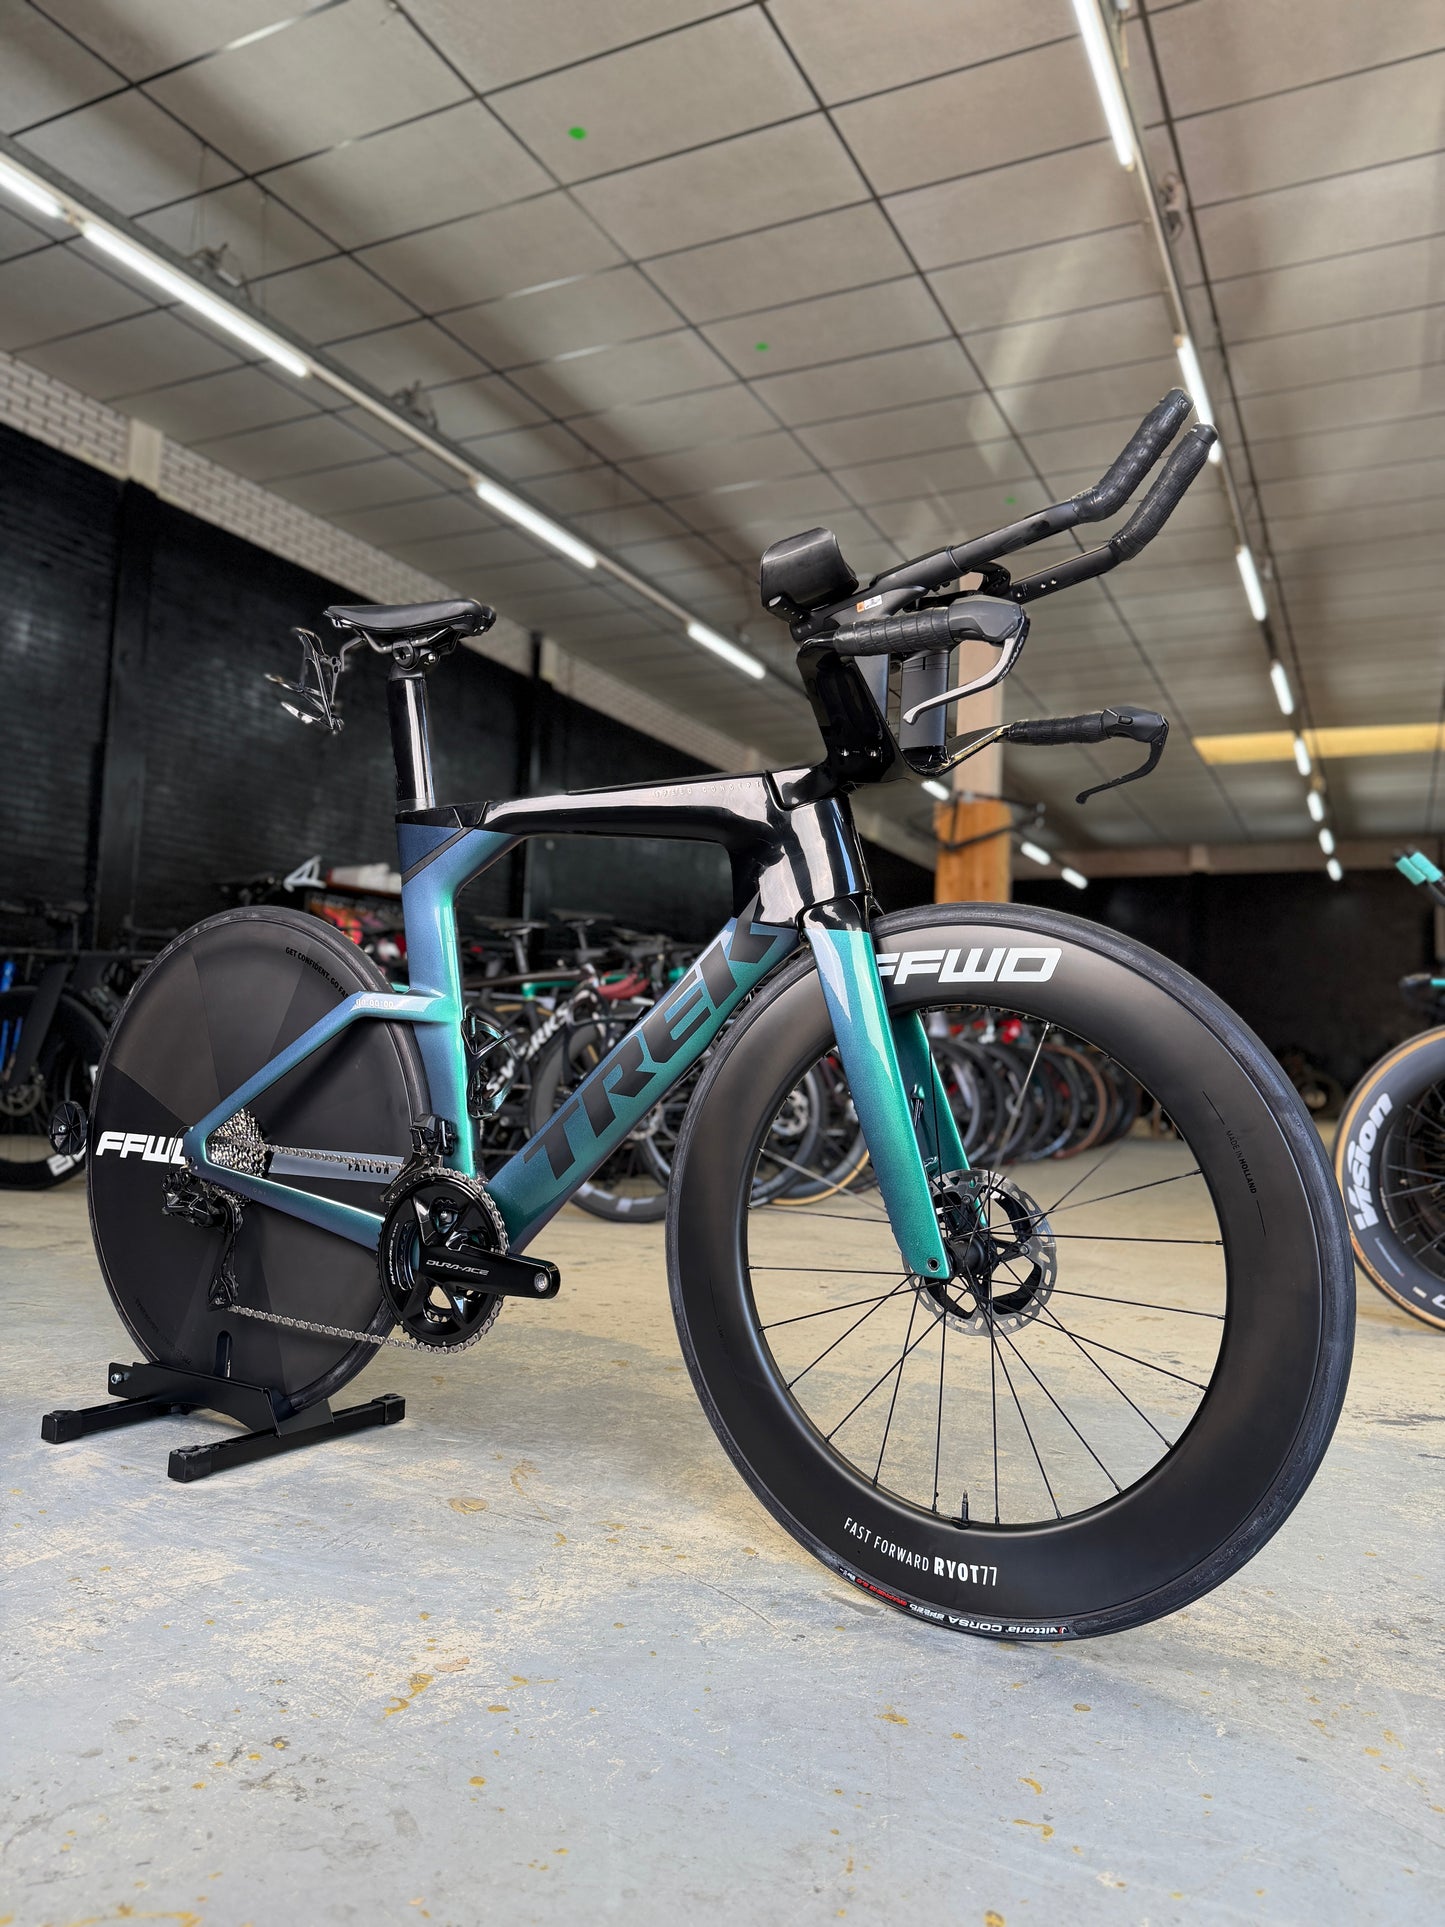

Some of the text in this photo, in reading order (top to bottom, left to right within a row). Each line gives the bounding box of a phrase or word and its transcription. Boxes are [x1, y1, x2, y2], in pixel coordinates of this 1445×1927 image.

[702, 780, 762, 793] CONCEPT
[285, 946, 350, 999] GET CONFIDENT. GO FAS
[523, 892, 778, 1180] TREK
[1238, 1158, 1258, 1195] HOLLAND
[1347, 1092, 1393, 1231] Vision
[425, 1259, 490, 1277] DURA-ACE
[843, 1516, 998, 1587] FAST FORWARD RYOT77
[947, 1614, 1003, 1632] CORSA
[1007, 1625, 1058, 1634] vittoria
